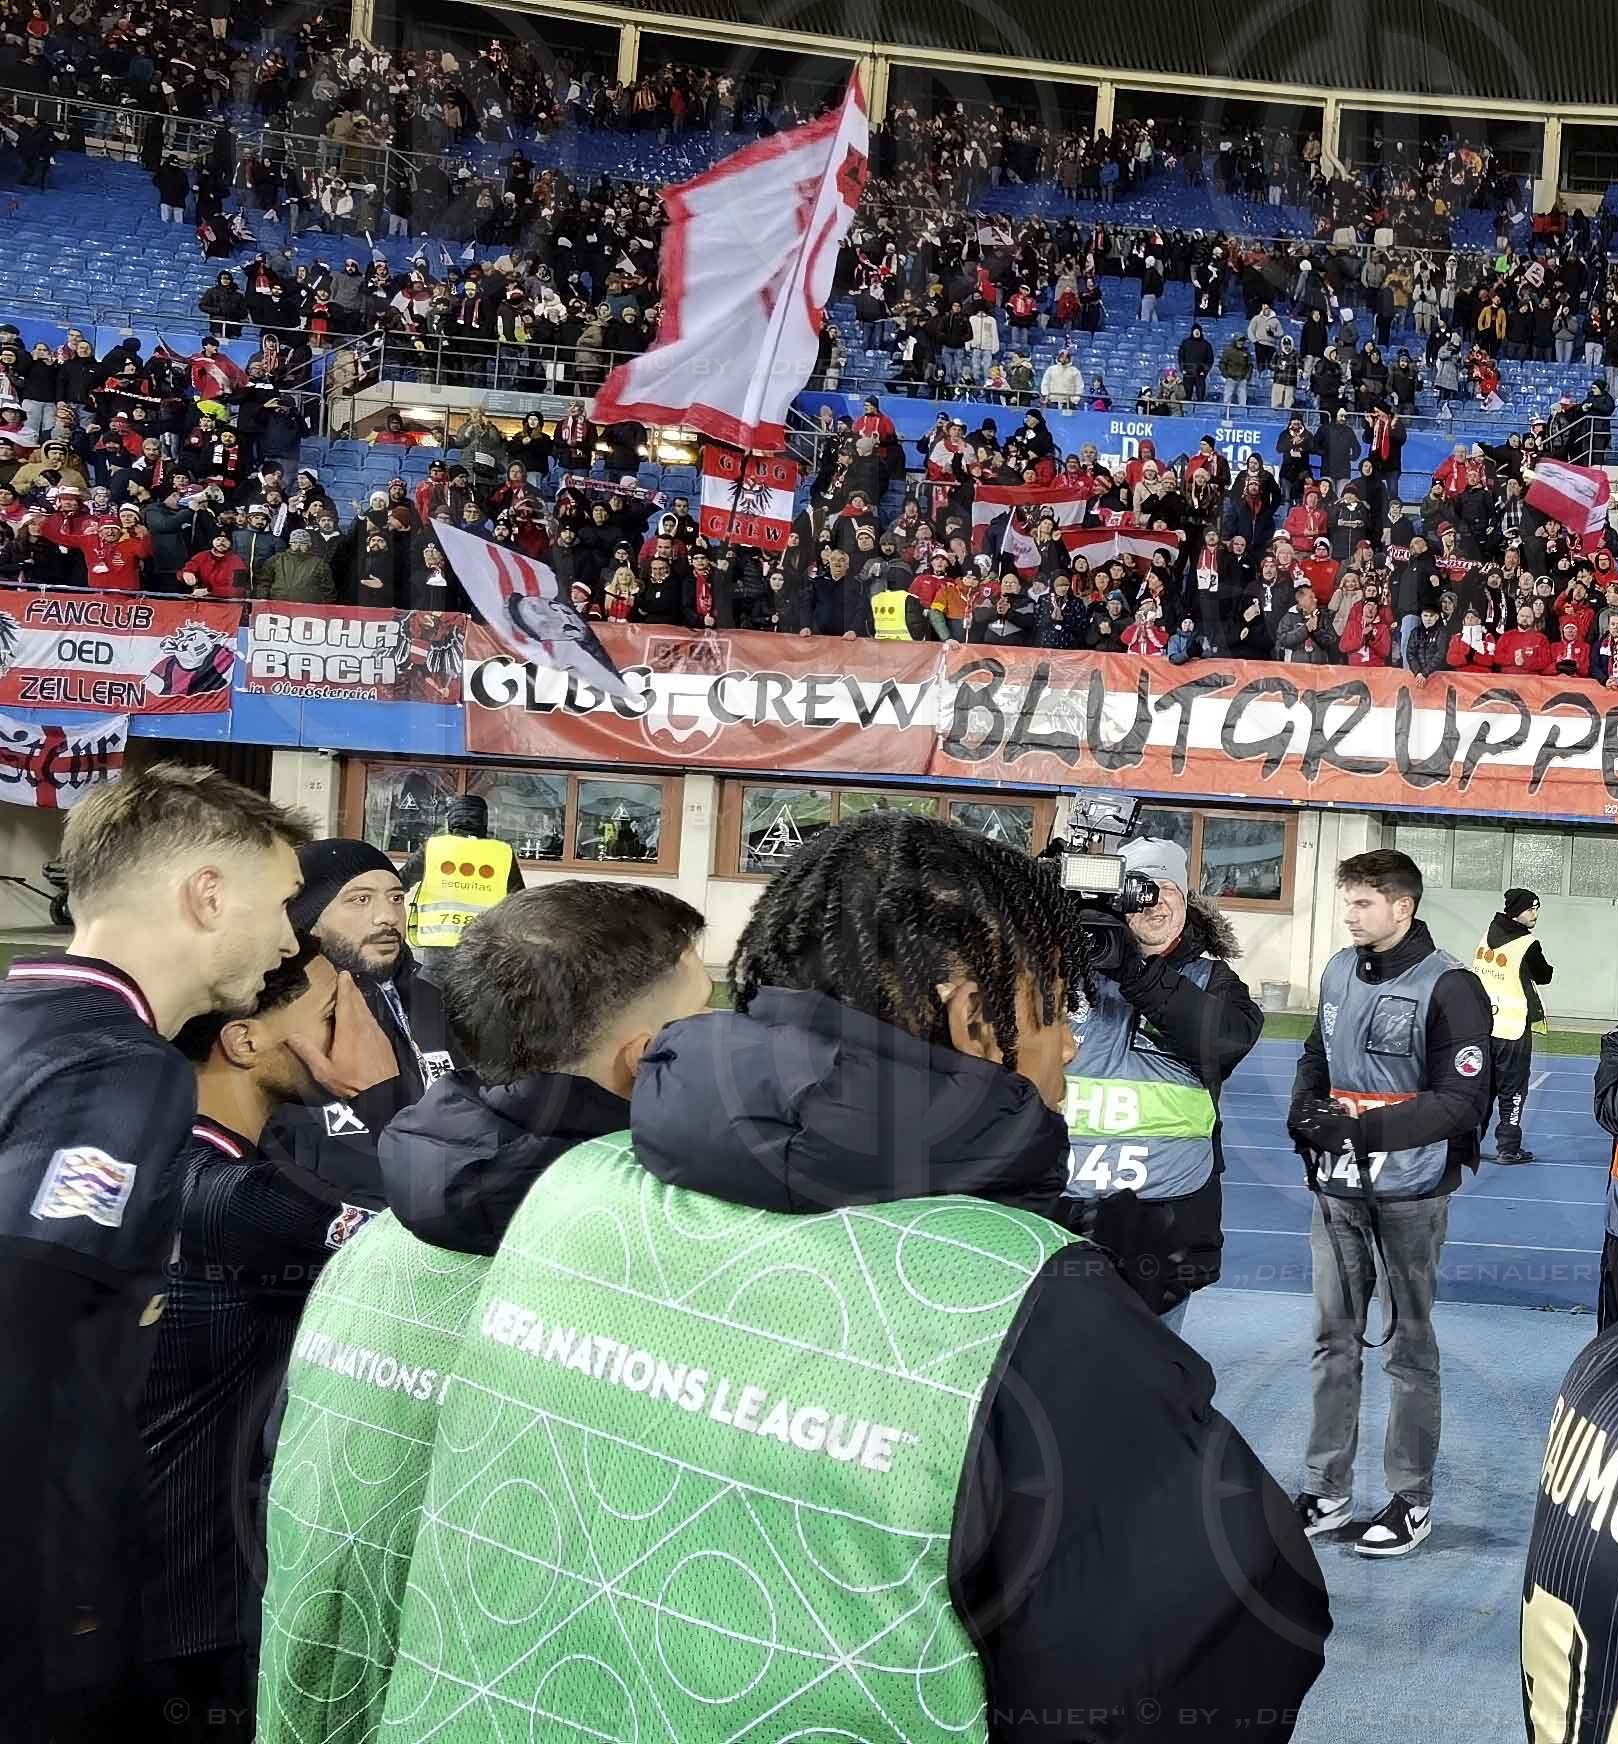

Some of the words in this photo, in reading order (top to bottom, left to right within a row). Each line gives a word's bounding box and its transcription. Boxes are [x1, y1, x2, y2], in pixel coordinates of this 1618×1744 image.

[1110, 421, 1153, 436] BLOCK
[1215, 428, 1261, 444] STIEGE
[25, 600, 154, 630] FANCLUB
[253, 613, 401, 649] ROHR
[58, 639, 114, 665] OED
[251, 649, 397, 685] BACH
[19, 676, 147, 708] ZEILLERN
[707, 670, 938, 732] CREW
[1067, 1144, 1149, 1191] 45
[543, 1325, 709, 1413] NATIONS
[709, 1376, 904, 1474] LEAGUE
